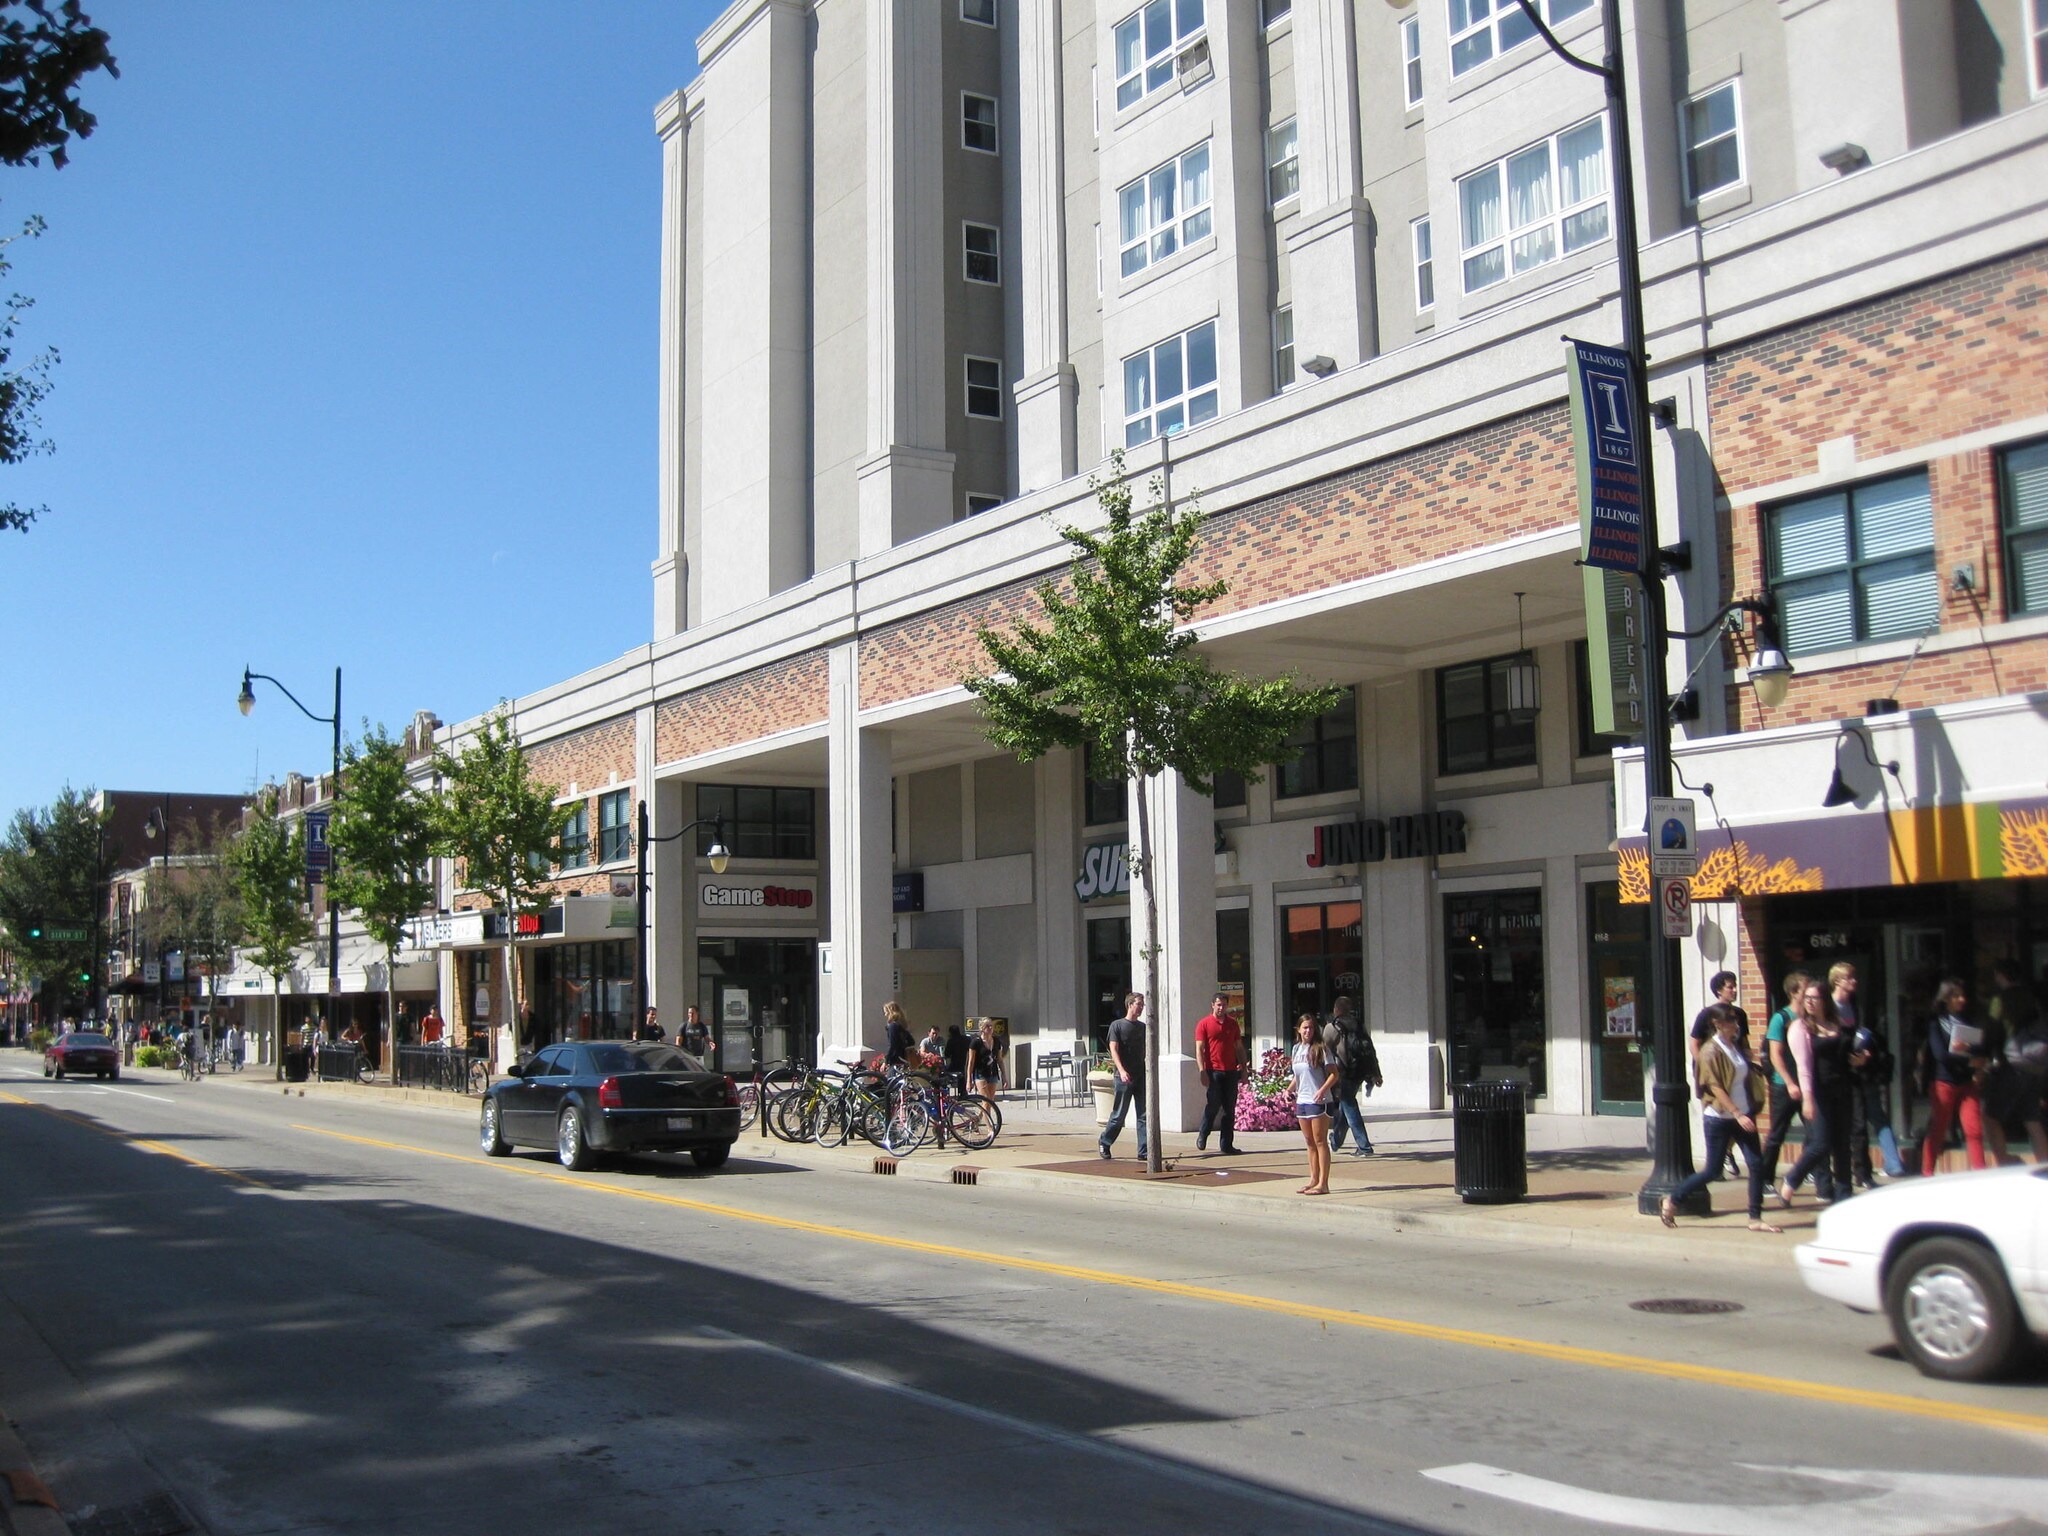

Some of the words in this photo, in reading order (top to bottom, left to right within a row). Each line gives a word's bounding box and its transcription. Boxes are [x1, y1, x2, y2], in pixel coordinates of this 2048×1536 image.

[1578, 349, 1626, 369] ILLINOIS
[1604, 443, 1630, 457] 1867
[1595, 467, 1640, 486] ILLINOIS
[1595, 487, 1640, 506] ILLINOIS
[1595, 506, 1640, 525] ILLINOIS
[1594, 527, 1639, 545] ILLINOIS
[1591, 545, 1638, 565] ILLINOIS
[1623, 586, 1639, 723] BREAD
[1306, 819, 1386, 868] JUNO
[1389, 810, 1467, 860] HAIR
[703, 884, 813, 908] GameStop
[495, 914, 540, 934] GaeStop
[1334, 973, 1361, 989] OPEN
